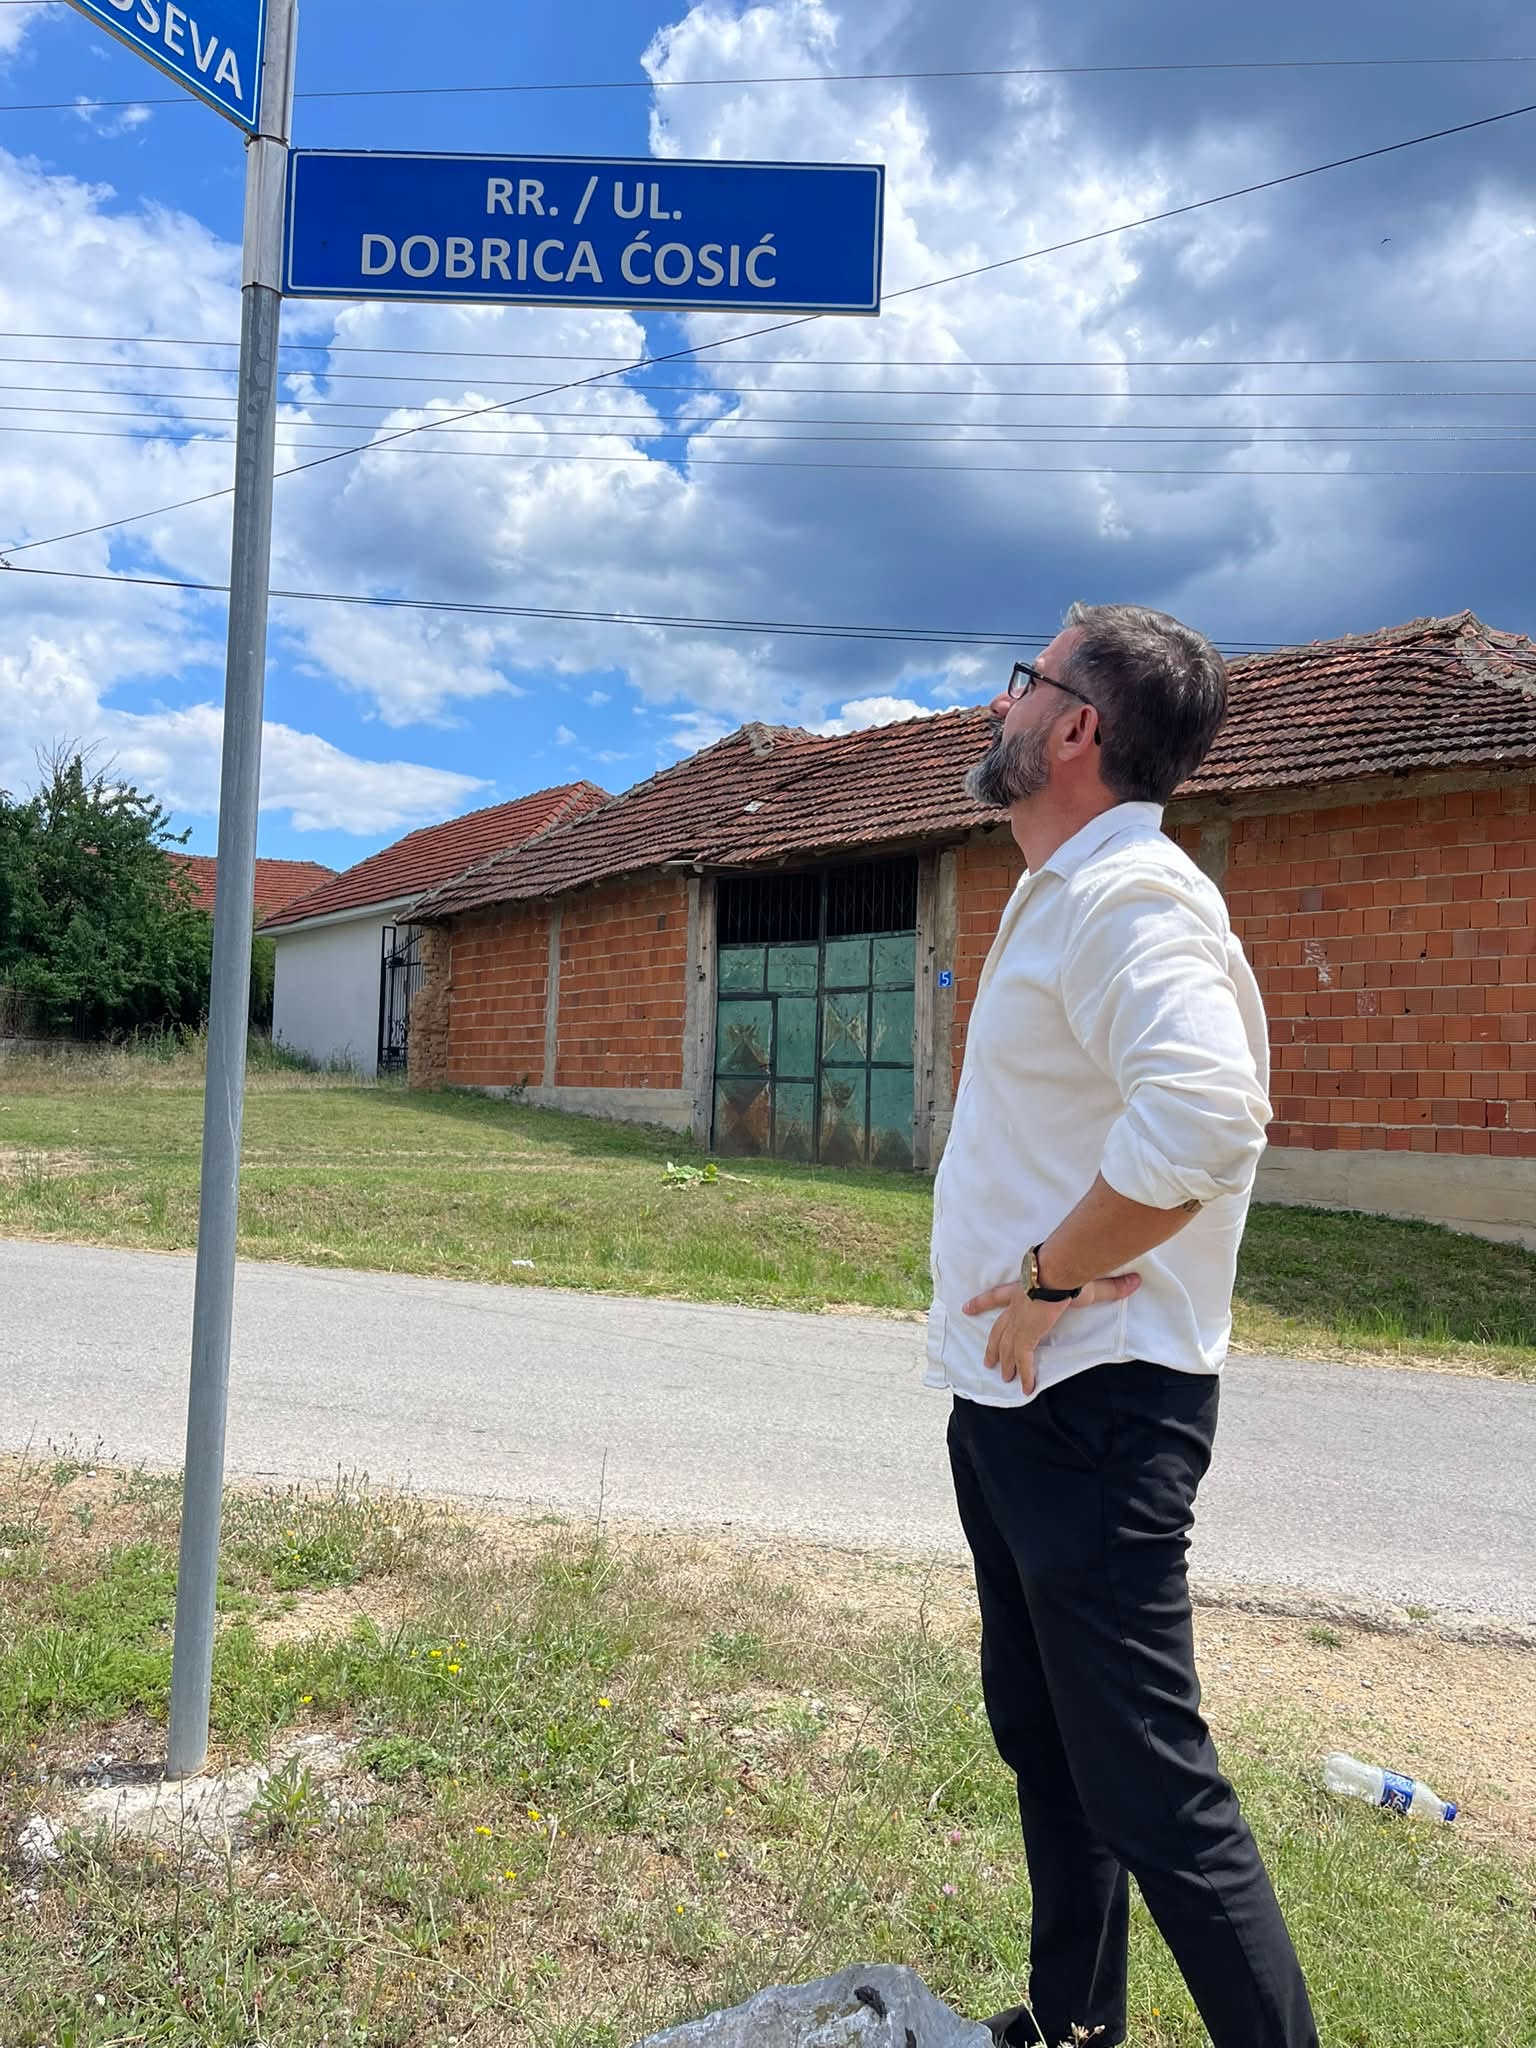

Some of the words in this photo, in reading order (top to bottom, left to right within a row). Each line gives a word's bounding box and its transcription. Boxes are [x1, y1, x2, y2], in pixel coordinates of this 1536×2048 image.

[108, 0, 243, 100] SEVA
[486, 178, 558, 216] RR.
[573, 176, 599, 225] /
[614, 181, 683, 221] UL.
[361, 233, 603, 283] DOBRICA
[620, 230, 777, 288] ĆOSIĆ
[941, 971, 950, 987] 5
